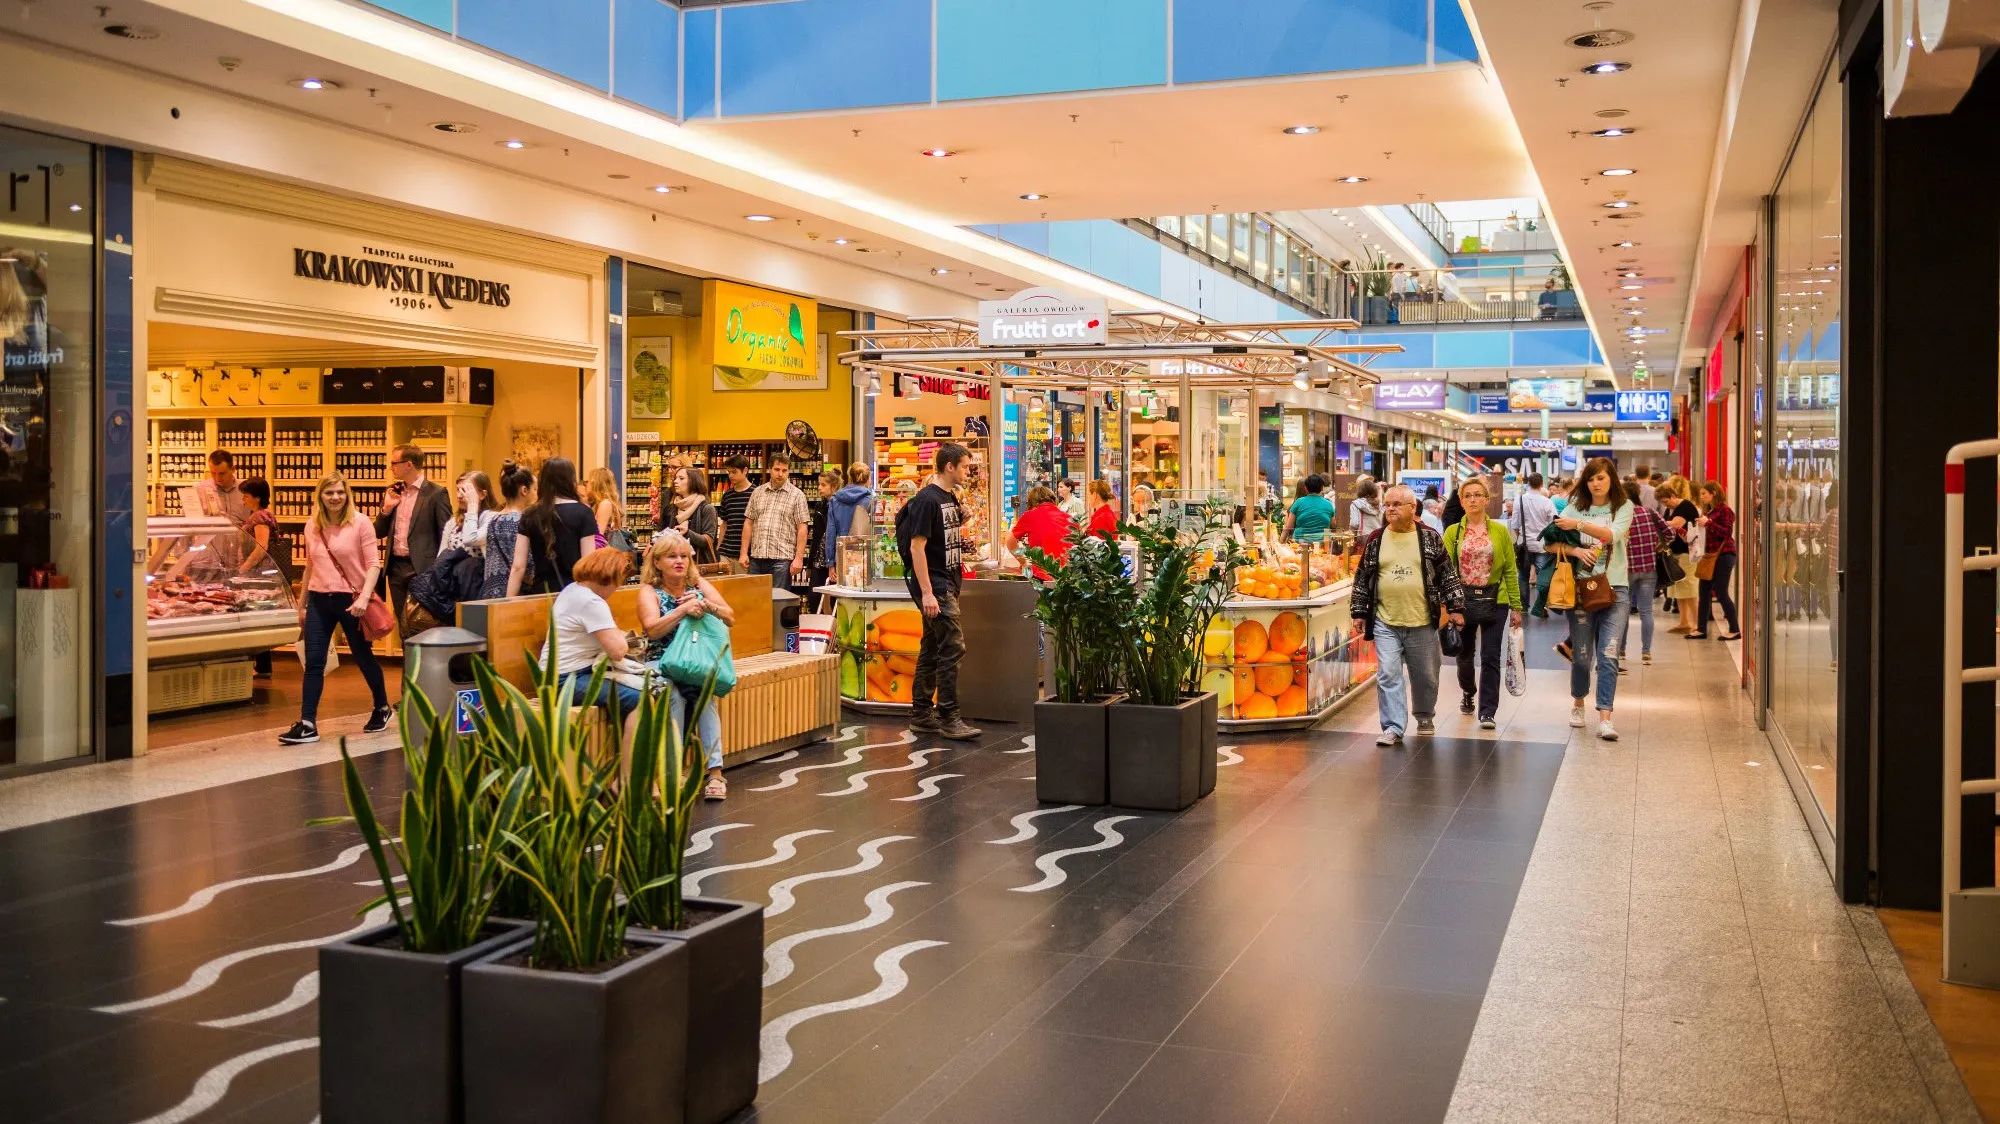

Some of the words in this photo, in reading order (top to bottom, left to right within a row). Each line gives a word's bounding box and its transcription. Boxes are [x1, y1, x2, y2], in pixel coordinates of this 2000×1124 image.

[362, 246, 405, 261] TRADYCJA
[408, 254, 455, 269] GALICYJSKA
[293, 247, 424, 294] KRAKOWSKI
[427, 270, 511, 310] KREDENS
[1043, 304, 1086, 313] OWOCÓW
[727, 307, 789, 361] Organic
[992, 317, 1047, 339] frutti
[1051, 319, 1086, 338] art
[1379, 383, 1439, 398] PLAY
